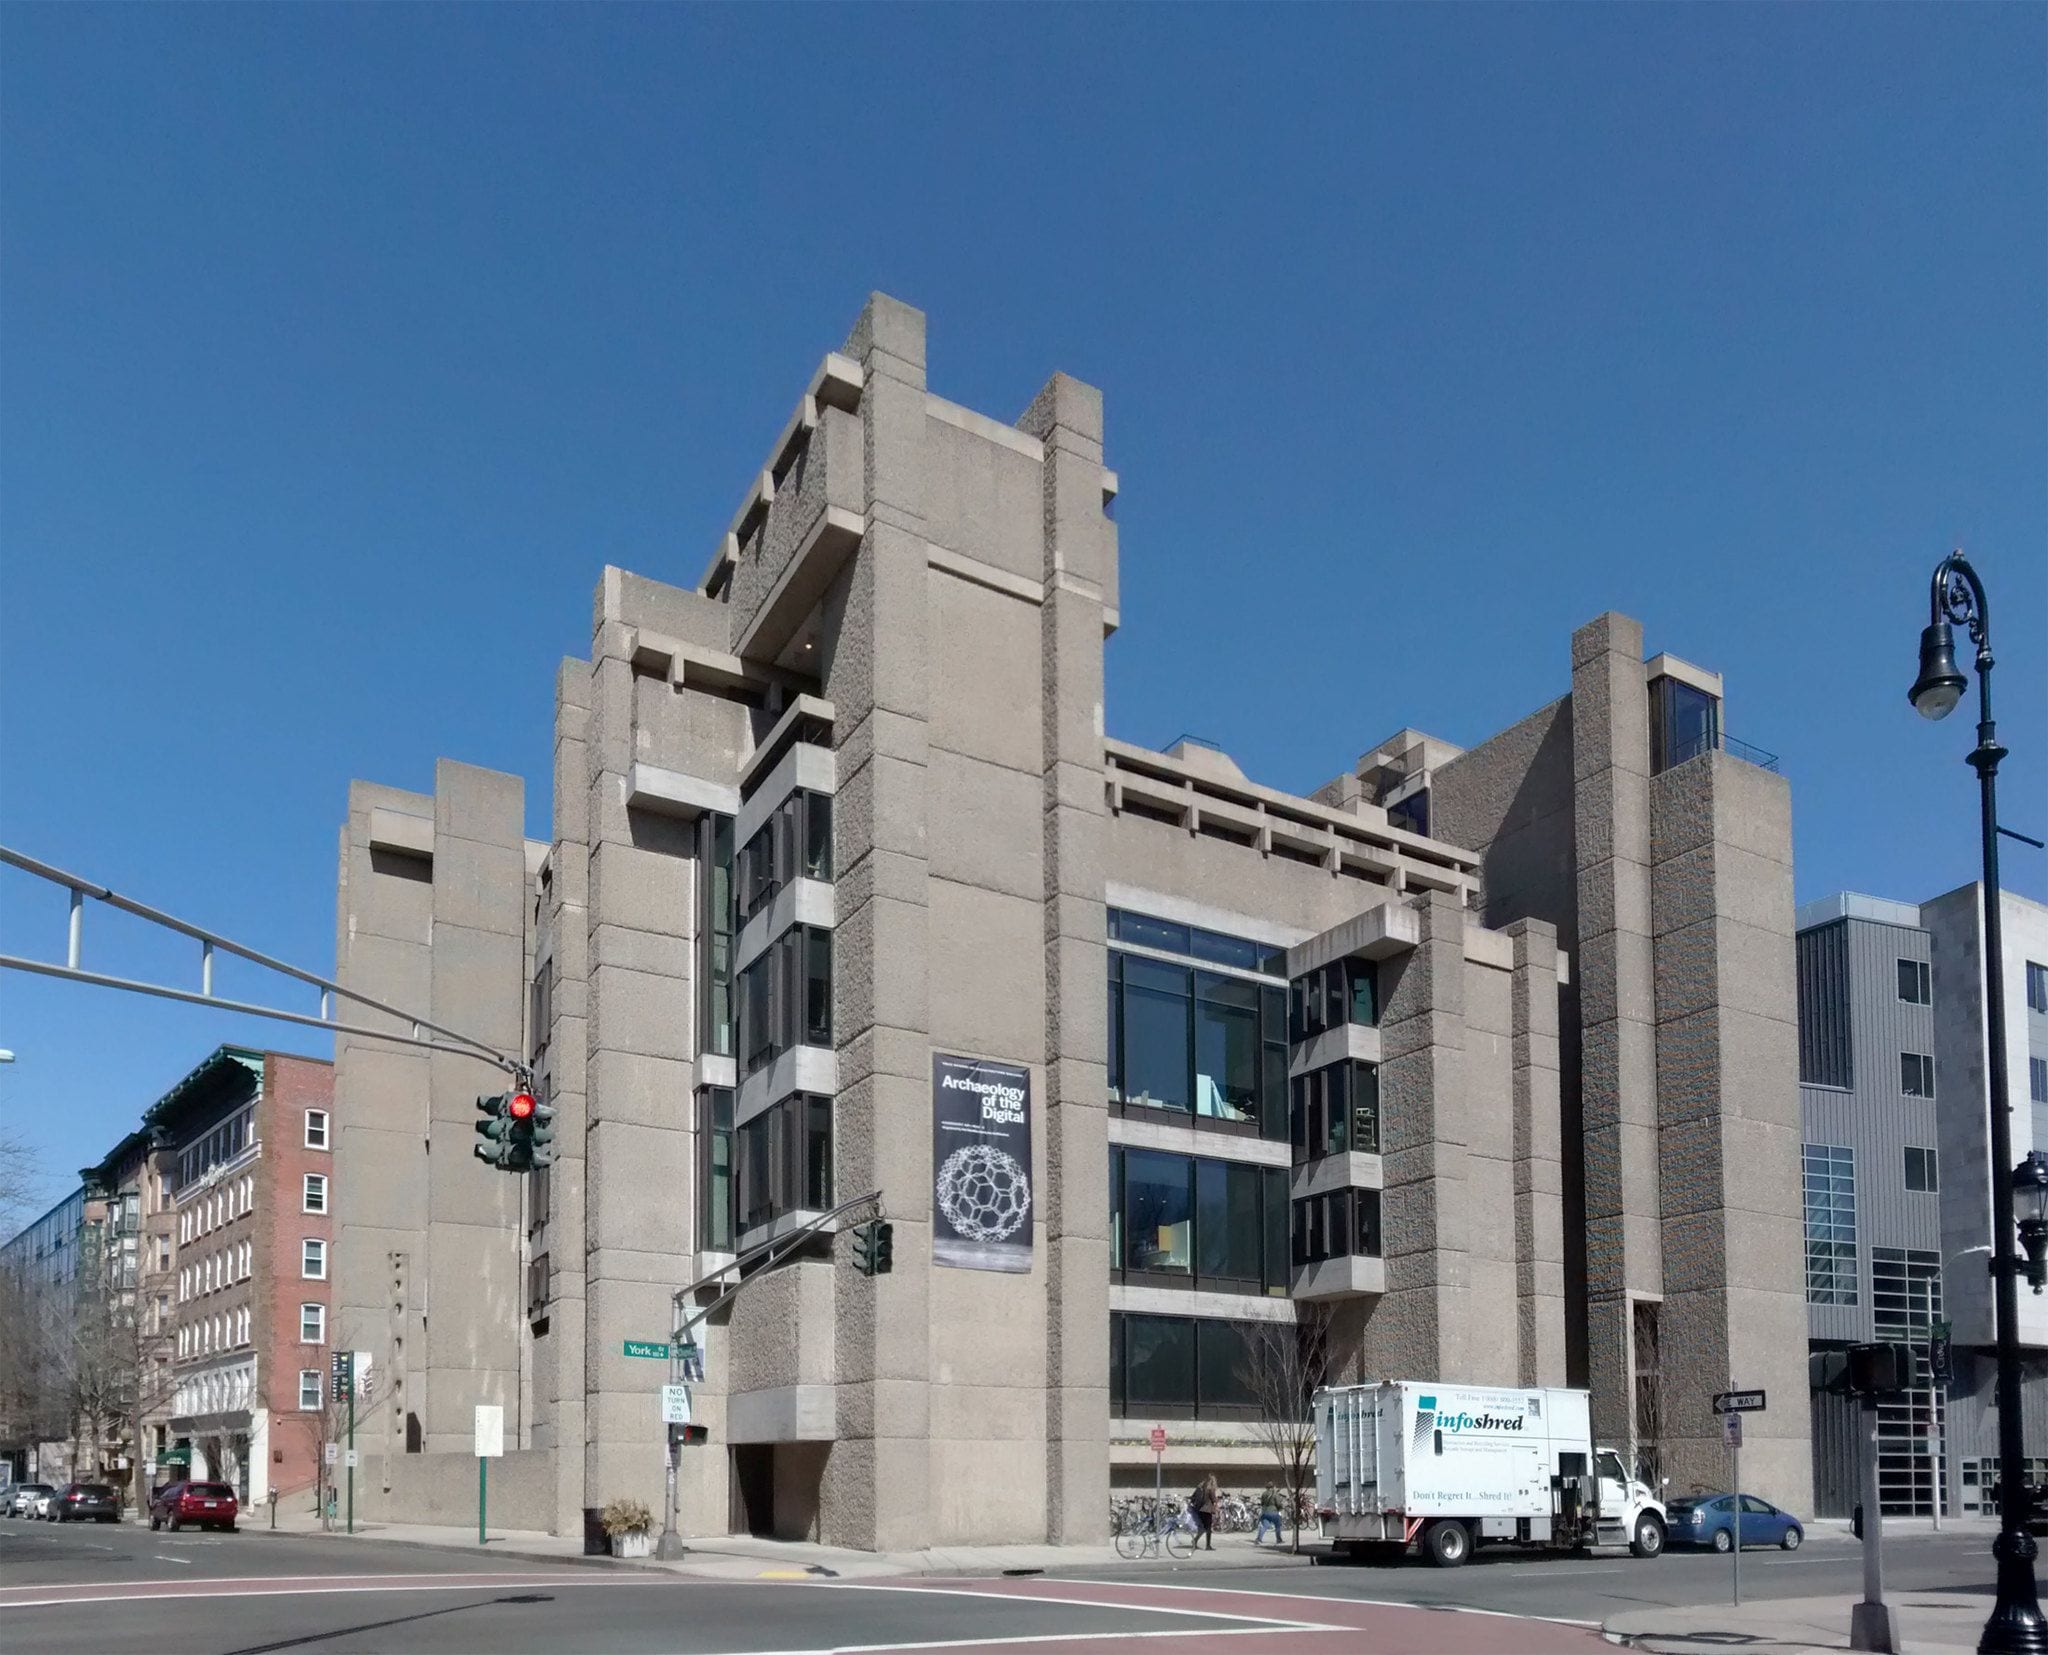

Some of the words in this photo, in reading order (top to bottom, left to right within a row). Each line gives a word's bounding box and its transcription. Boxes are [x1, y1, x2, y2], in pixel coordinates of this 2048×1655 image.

[942, 1075, 1025, 1101] Archaeology
[981, 1094, 998, 1107] of
[999, 1096, 1021, 1110] the
[982, 1106, 1025, 1123] Digital
[628, 1344, 652, 1356] York
[669, 1388, 683, 1396] NO
[1736, 1397, 1756, 1406] WAY
[1436, 1411, 1524, 1433] infoshred
[1413, 1490, 1435, 1500] Don't
[1437, 1491, 1463, 1501] Regret
